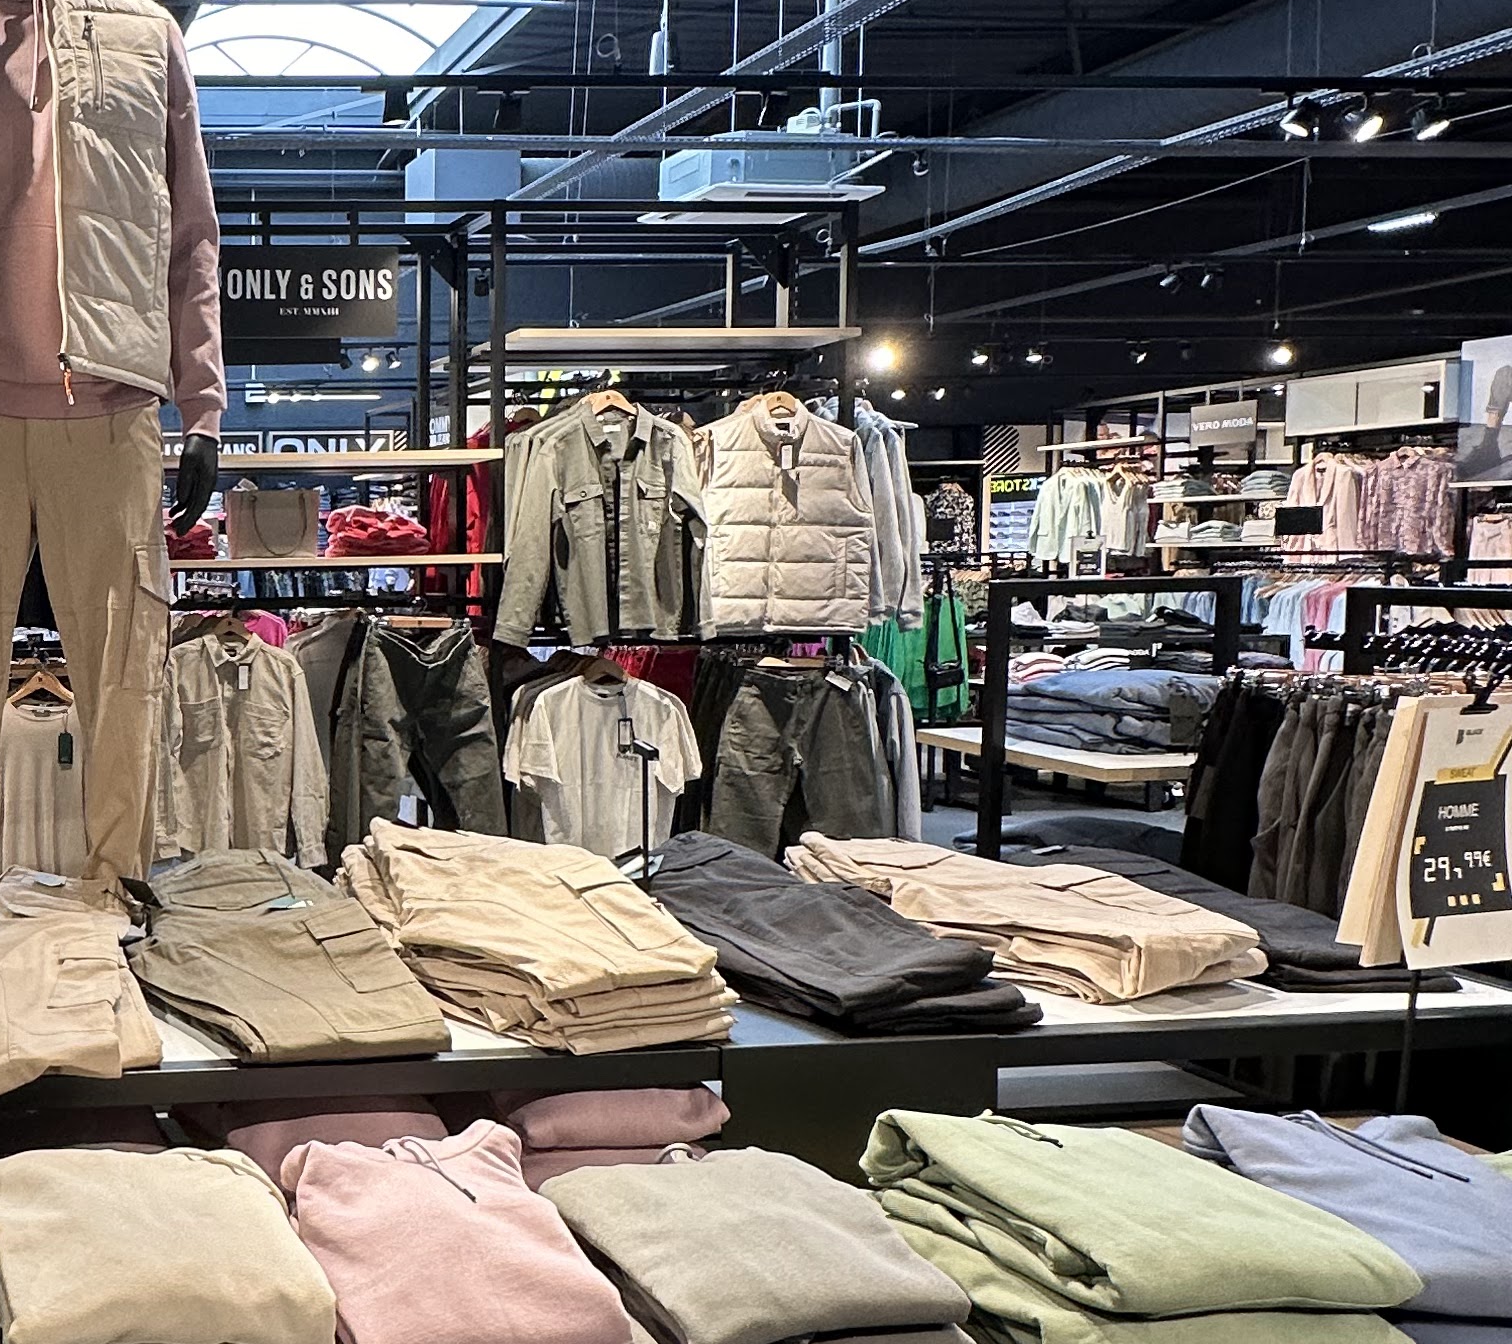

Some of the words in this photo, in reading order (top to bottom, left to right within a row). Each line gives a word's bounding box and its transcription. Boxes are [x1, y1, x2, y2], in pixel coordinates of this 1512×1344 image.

[226, 269, 292, 301] ONLY
[299, 273, 315, 301] &
[321, 268, 394, 301] SONS
[1191, 420, 1221, 432] VERO
[1221, 417, 1254, 429] MODA
[1437, 802, 1480, 820] HOMME
